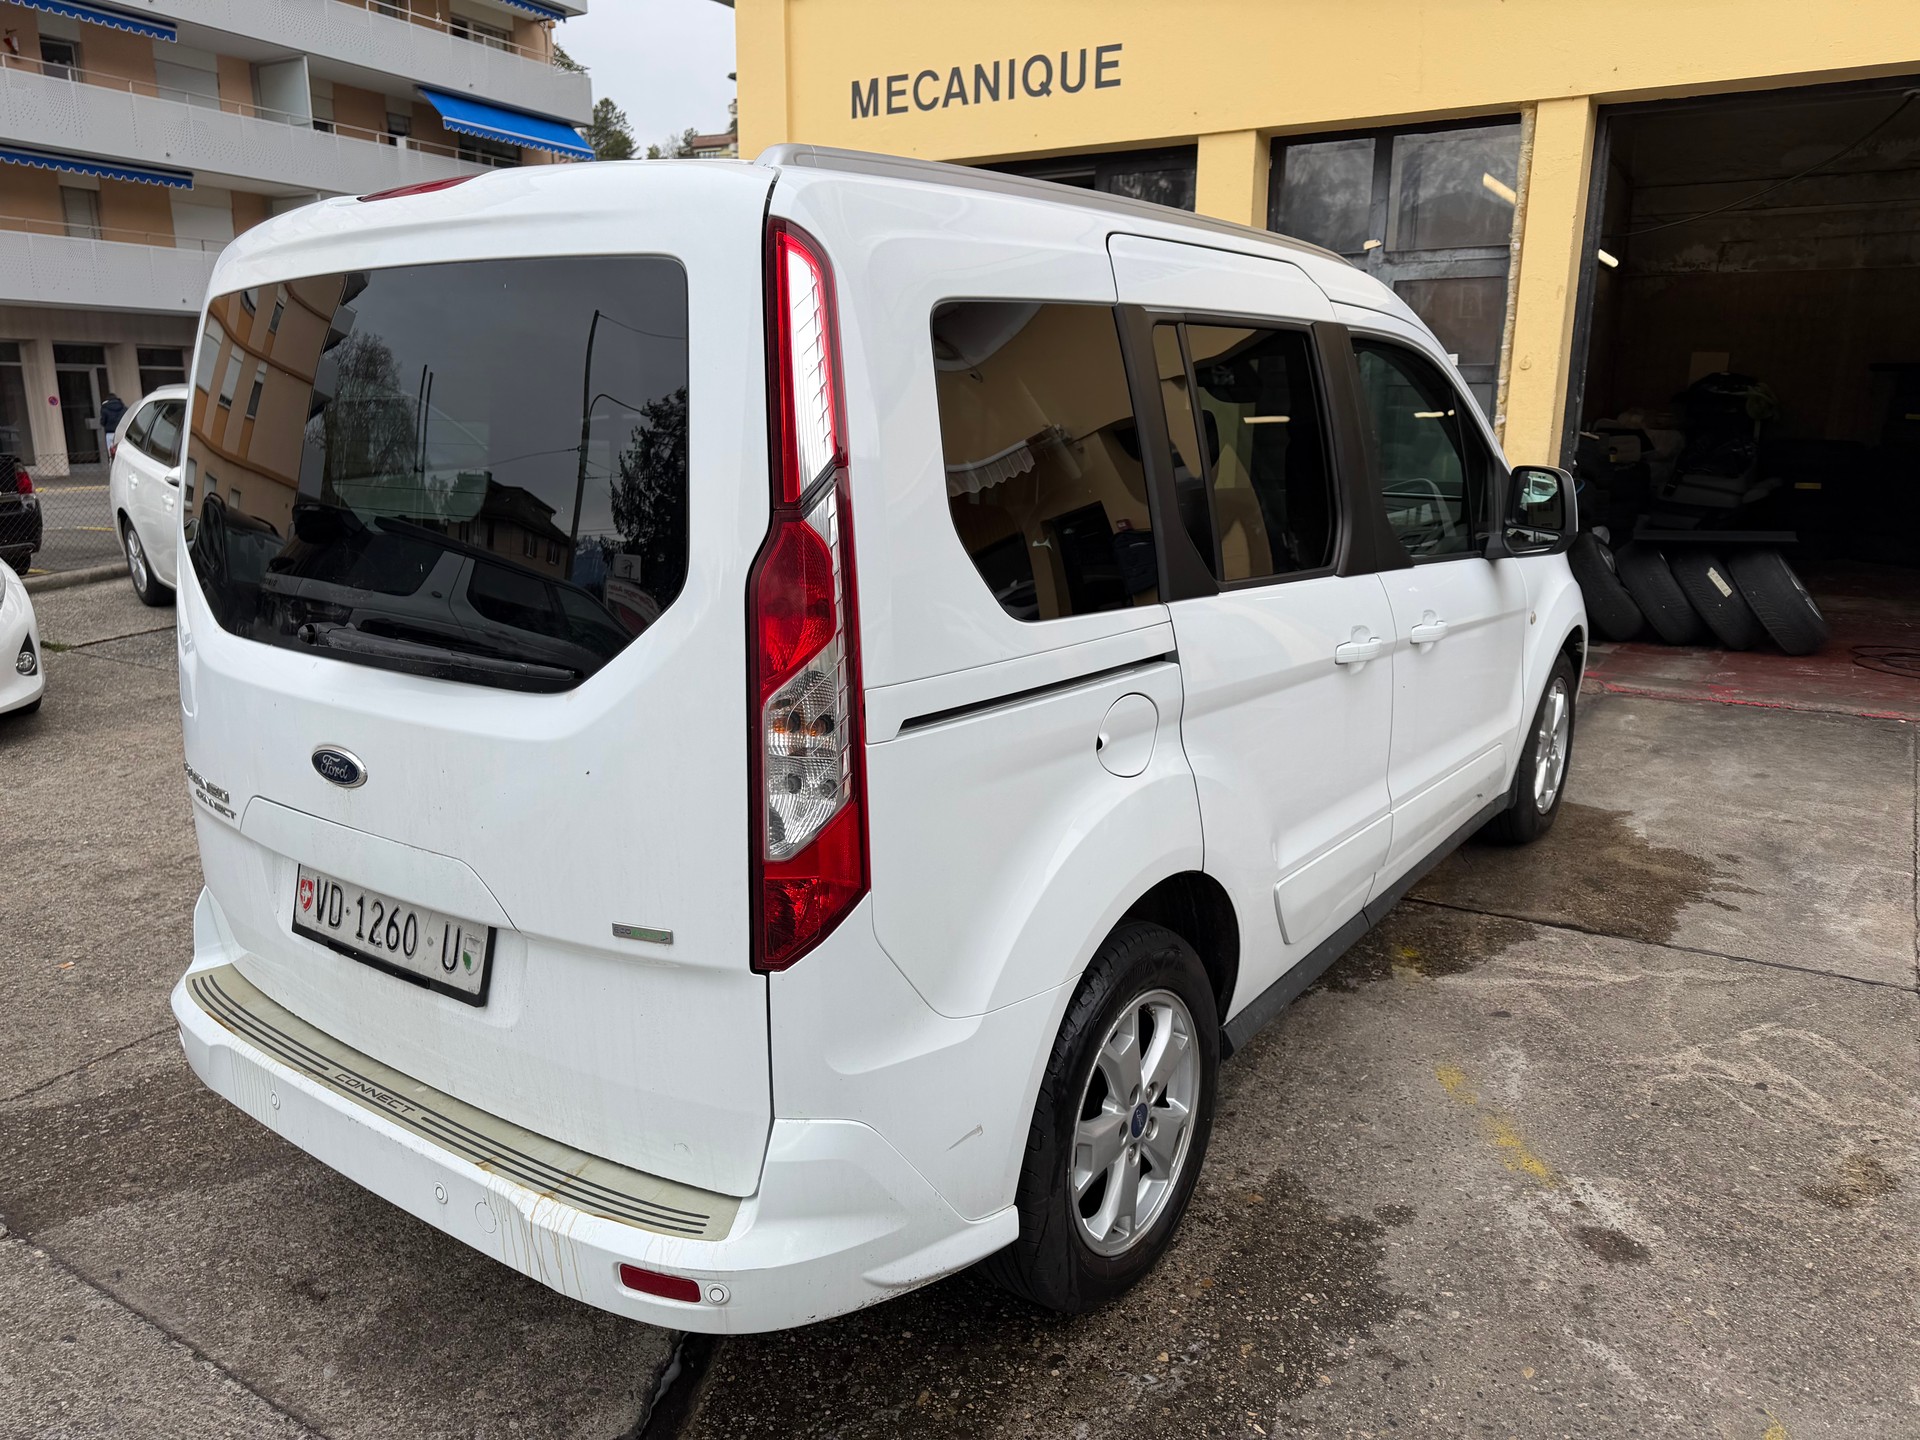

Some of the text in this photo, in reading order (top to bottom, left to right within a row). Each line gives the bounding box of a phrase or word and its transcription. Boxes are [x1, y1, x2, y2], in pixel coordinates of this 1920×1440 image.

[851, 43, 1123, 119] MECANIQUE
[320, 754, 349, 780] Ford
[333, 1073, 416, 1113] CONNECT
